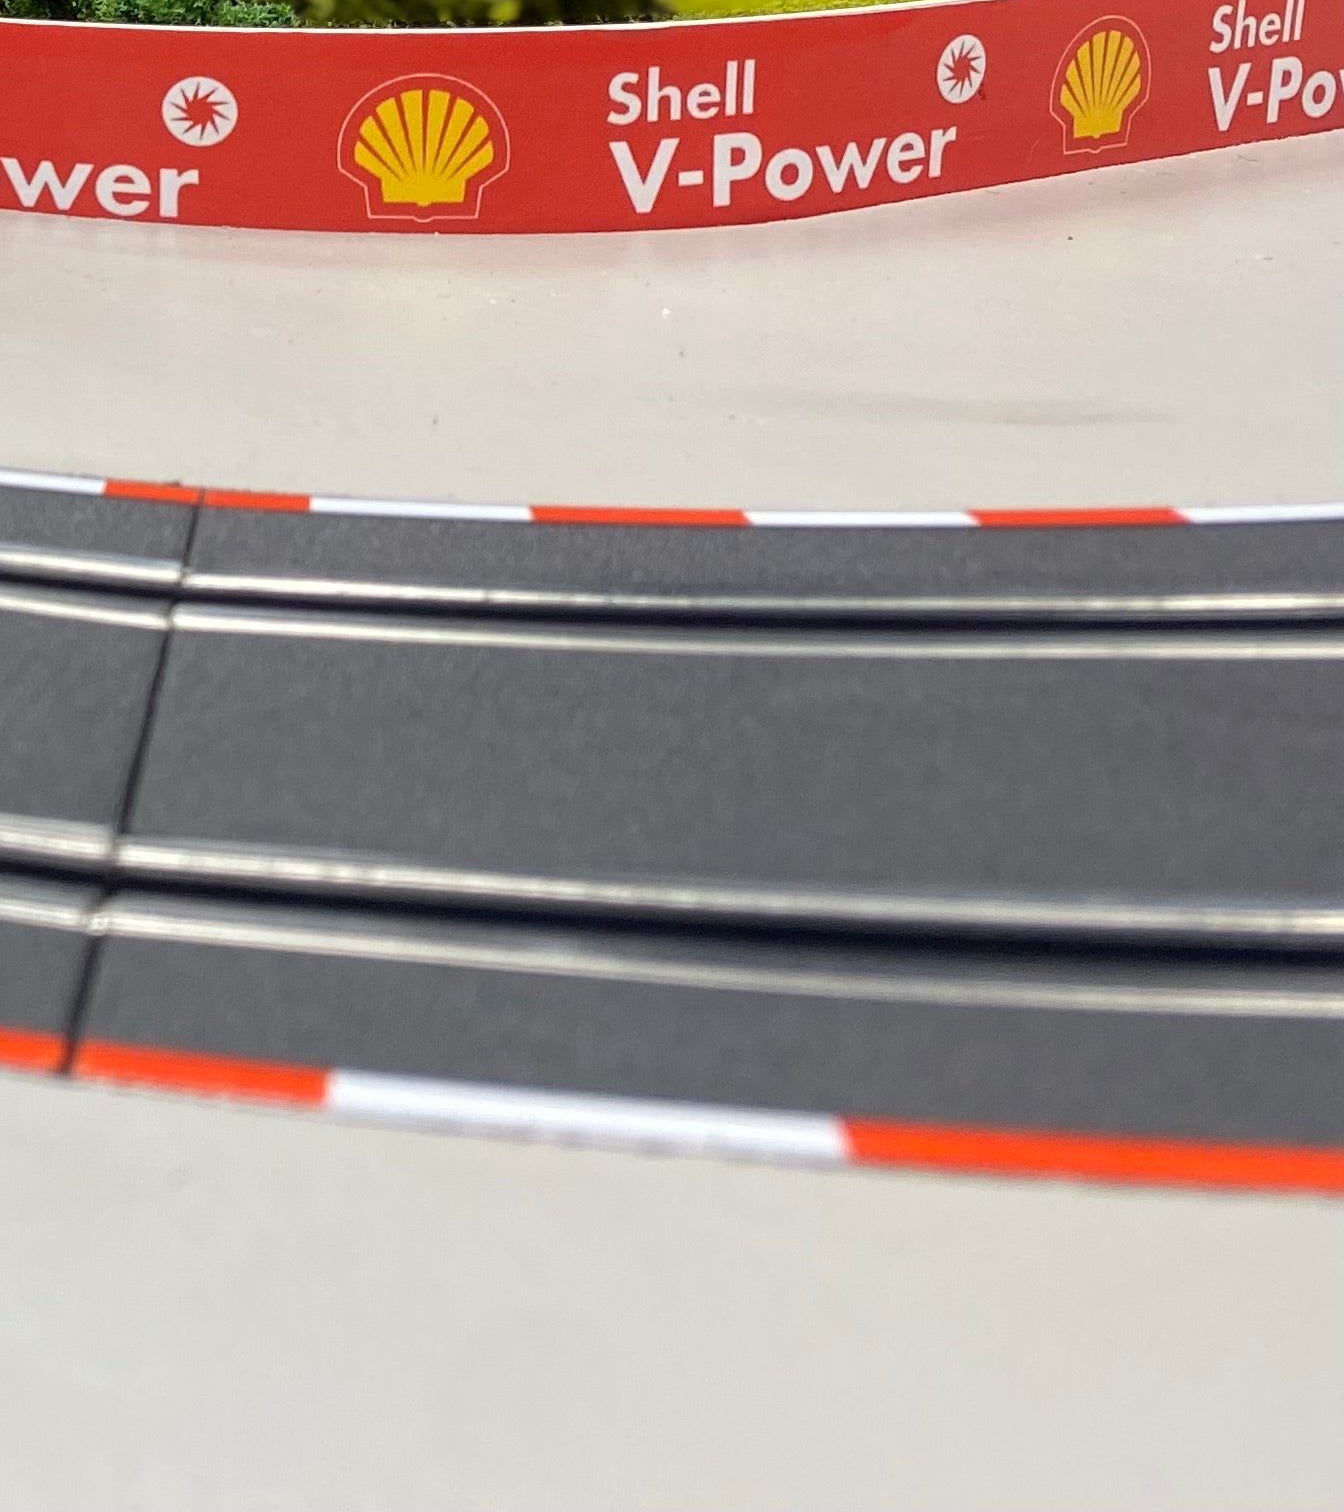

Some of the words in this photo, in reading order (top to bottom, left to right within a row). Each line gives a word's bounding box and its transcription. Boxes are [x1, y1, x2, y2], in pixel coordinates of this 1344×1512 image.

[607, 58, 756, 126] Shell
[1208, 55, 1344, 132] V-Po
[608, 125, 958, 215] V-Power
